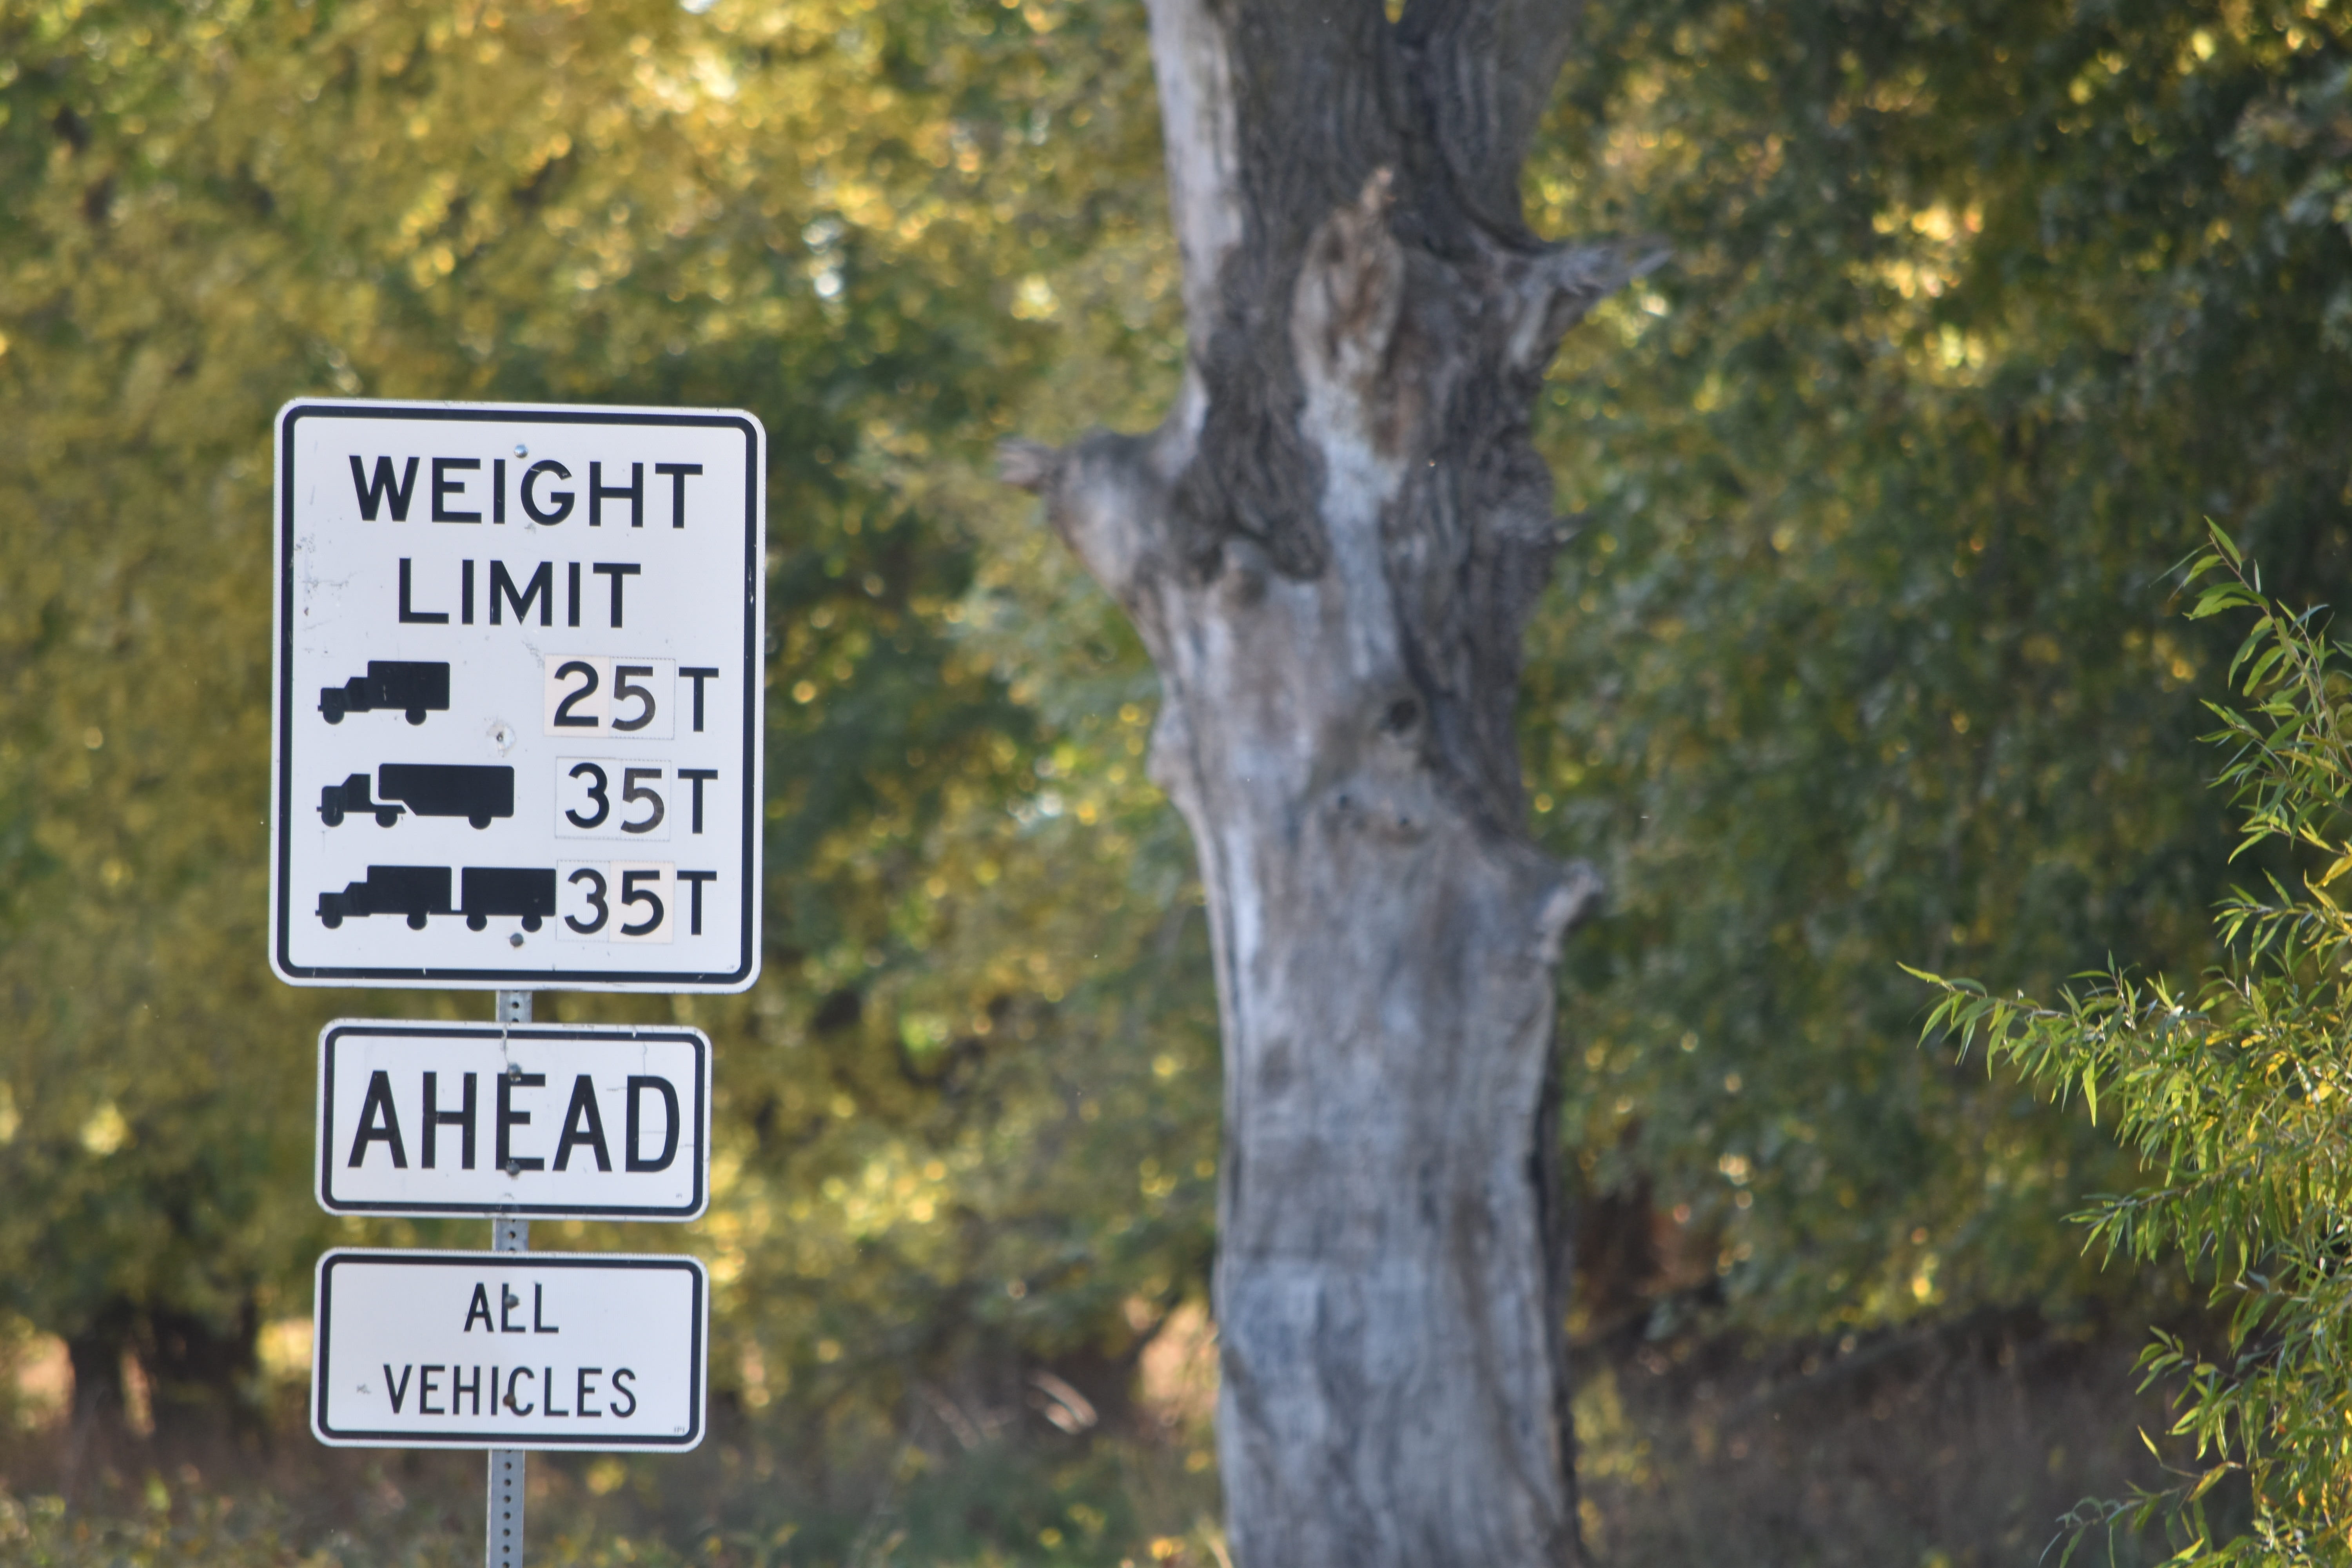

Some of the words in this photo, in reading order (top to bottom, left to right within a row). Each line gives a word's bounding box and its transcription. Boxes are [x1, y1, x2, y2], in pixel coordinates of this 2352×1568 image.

[349, 455, 703, 528] WEIGHT
[399, 558, 641, 628] LIMIT
[347, 1070, 680, 1173] AHEAD
[464, 1283, 559, 1333] ALL
[383, 1364, 637, 1418] VEHICLES
